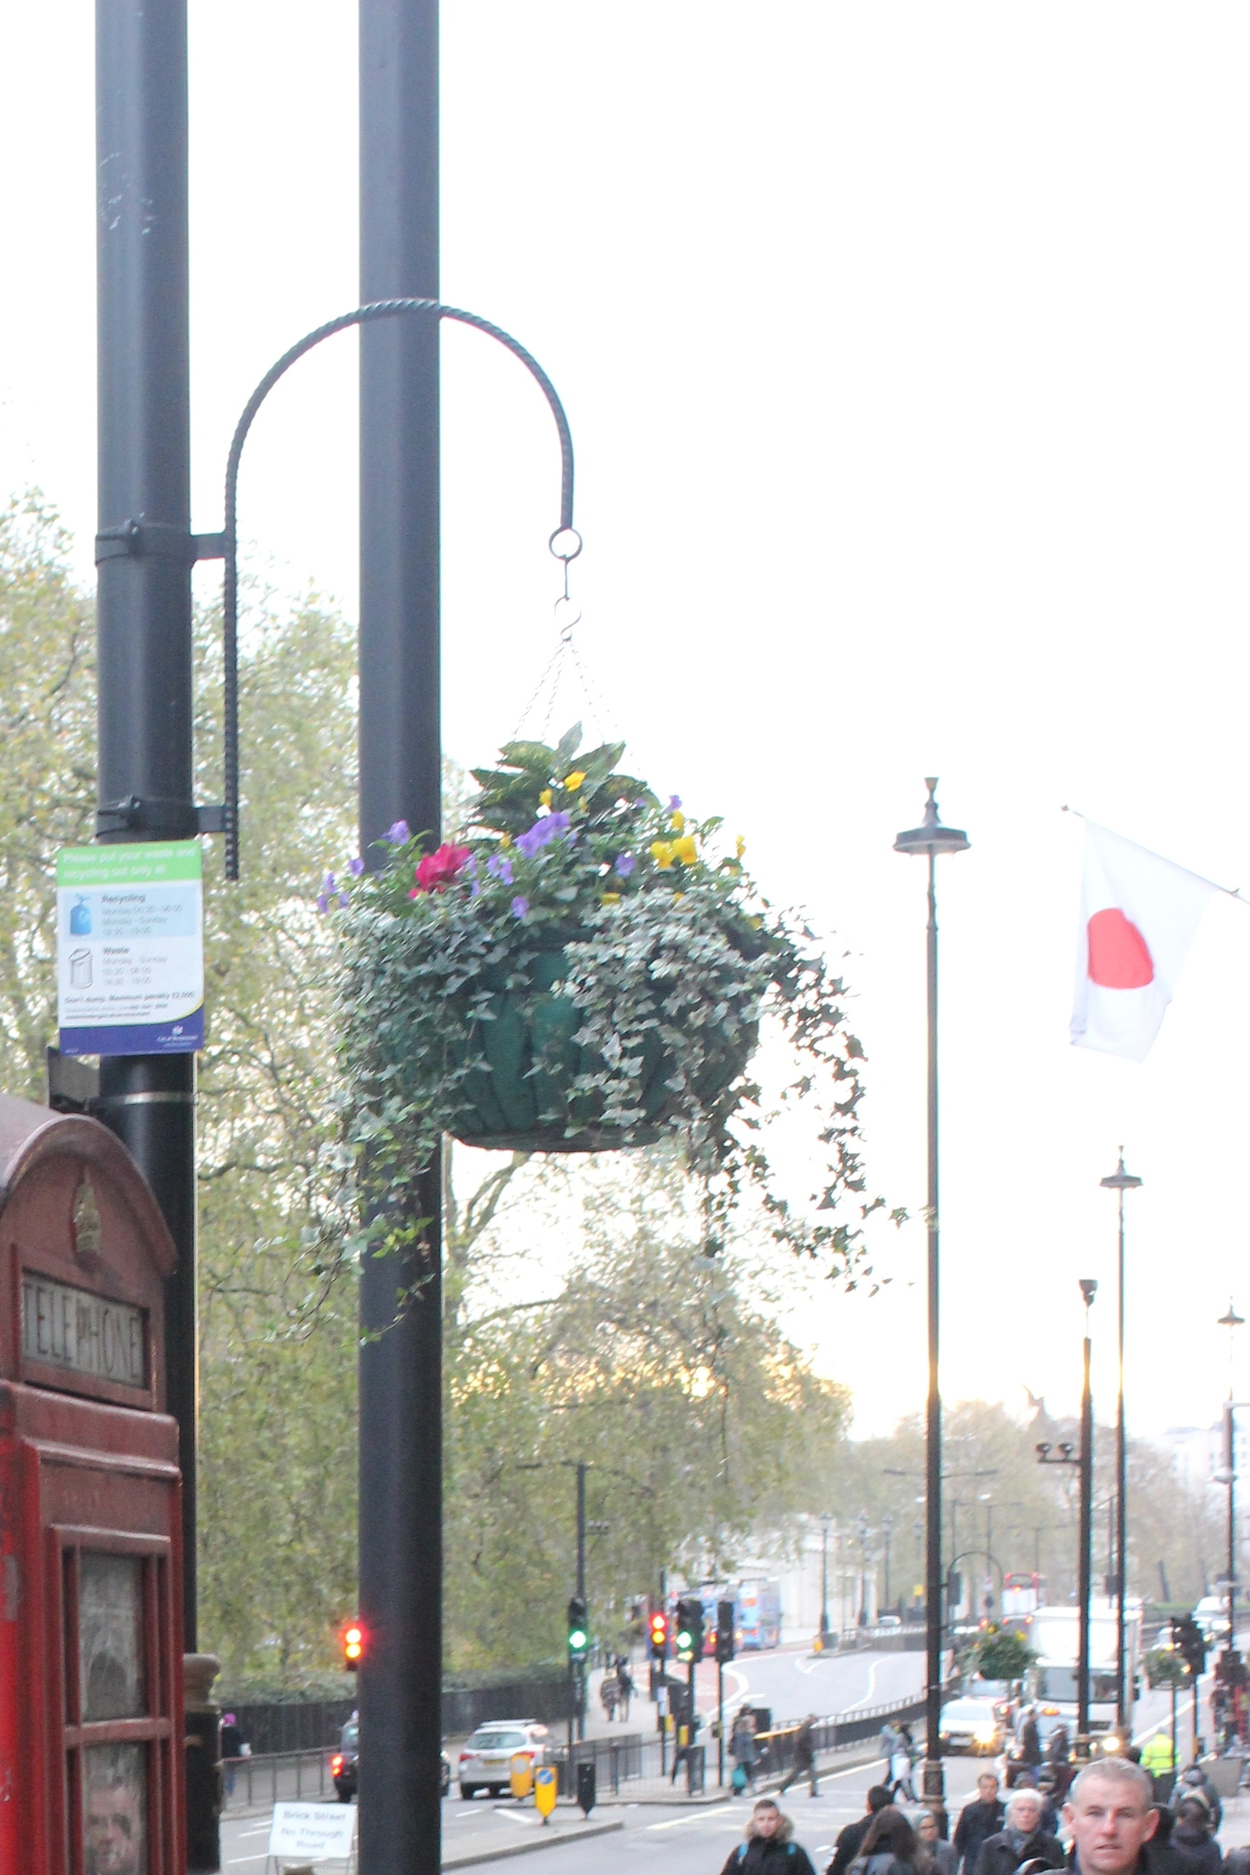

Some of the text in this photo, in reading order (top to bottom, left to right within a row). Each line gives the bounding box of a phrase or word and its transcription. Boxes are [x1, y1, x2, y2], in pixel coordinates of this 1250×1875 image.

[101, 894, 146, 904] Recycling
[22, 1282, 141, 1378] TELEPHONE
[314, 1811, 346, 1820] Street
[300, 1828, 344, 1838] Through
